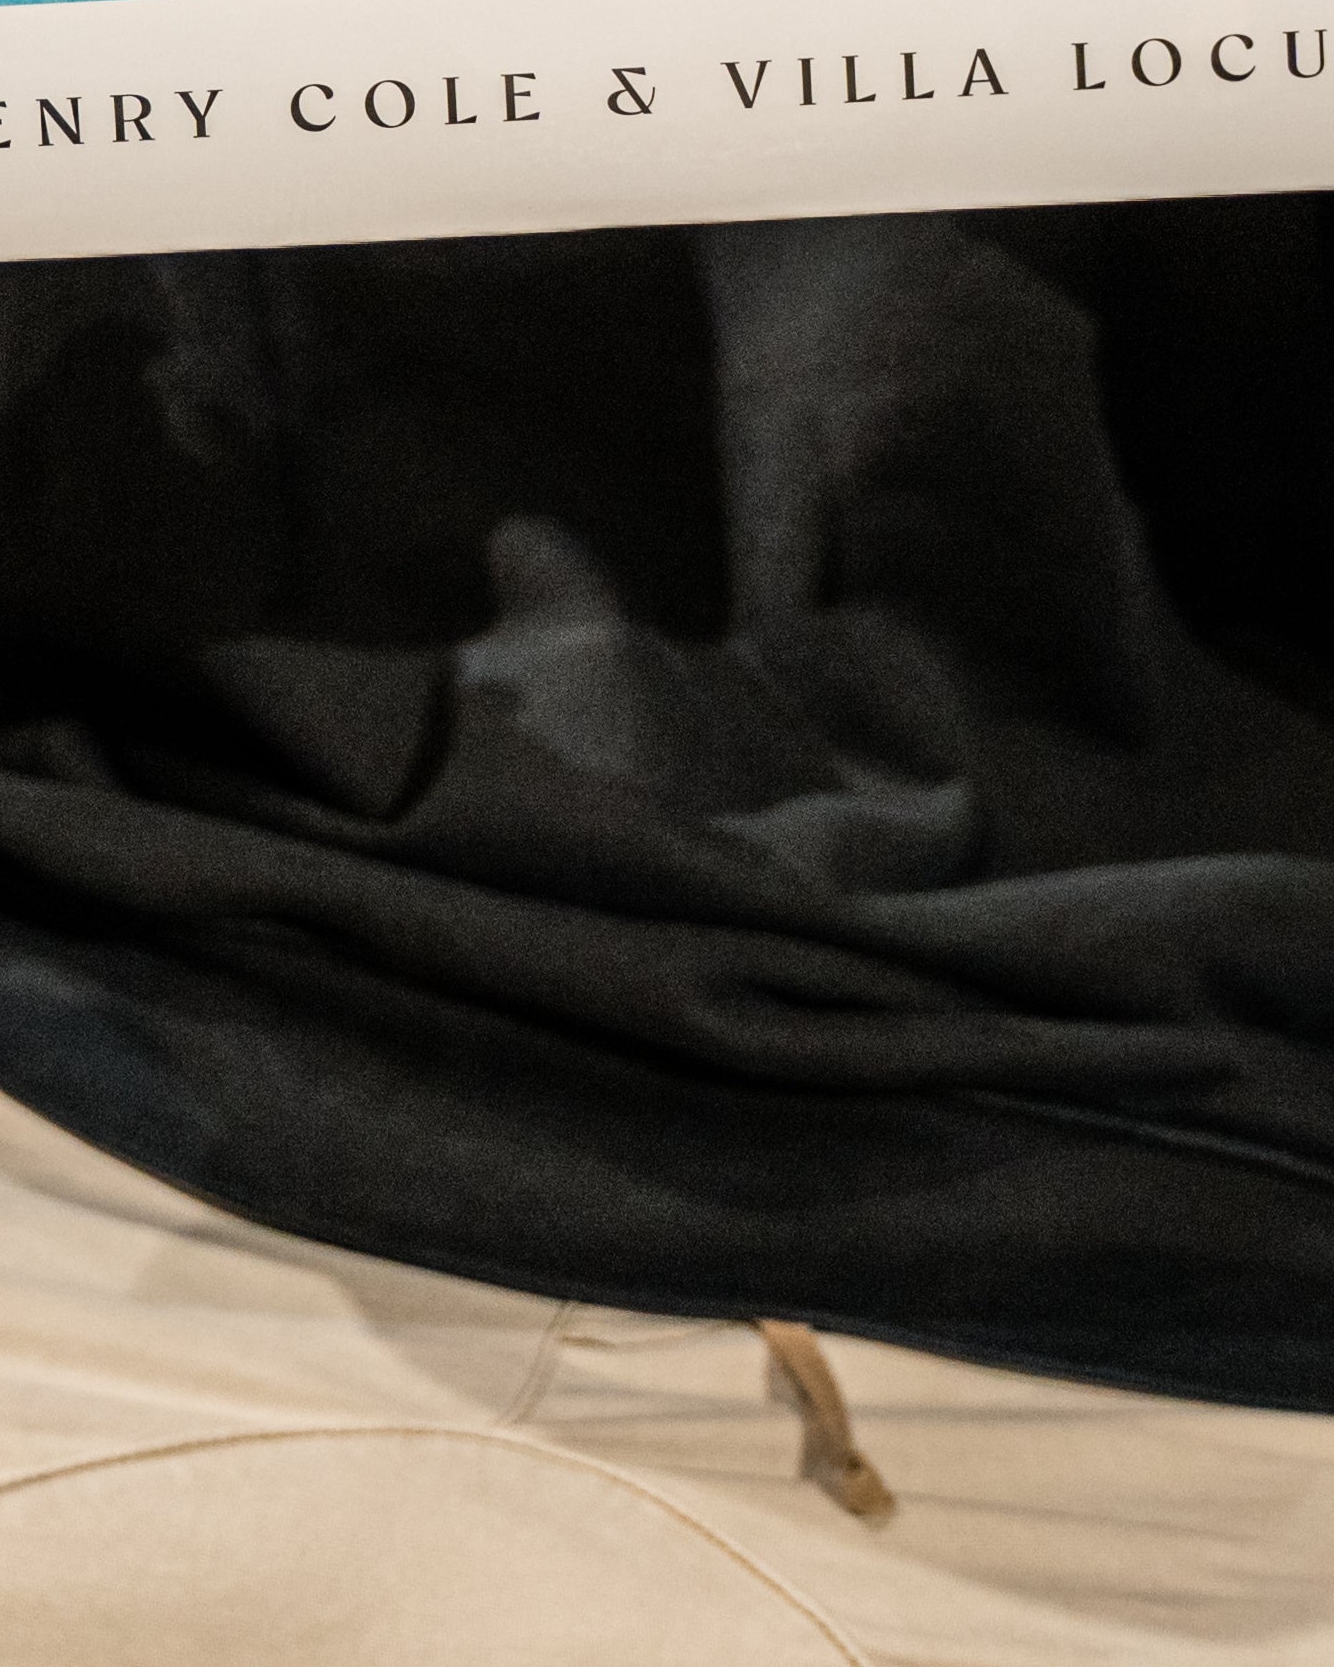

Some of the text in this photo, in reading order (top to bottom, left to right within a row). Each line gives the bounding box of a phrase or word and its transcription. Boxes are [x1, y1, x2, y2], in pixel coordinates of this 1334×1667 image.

[289, 72, 542, 133] COLE
[606, 66, 656, 117] &
[719, 47, 1010, 110] VILLA
